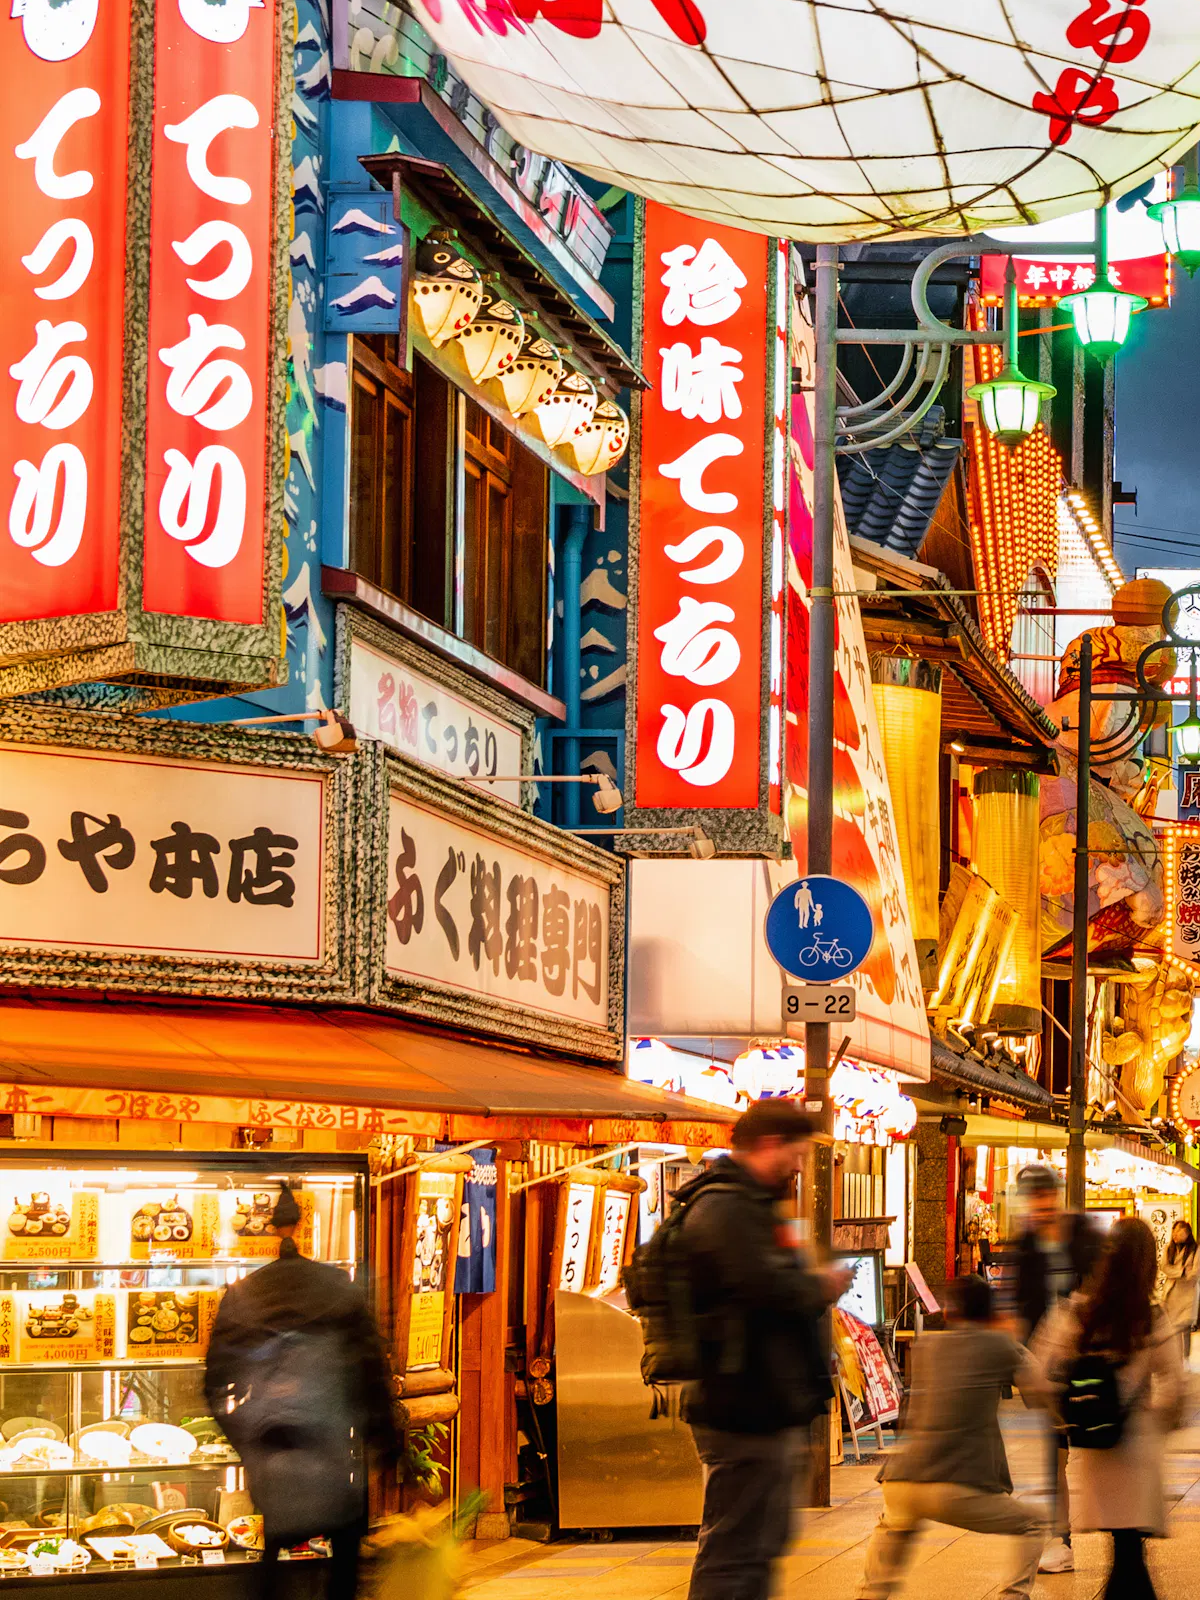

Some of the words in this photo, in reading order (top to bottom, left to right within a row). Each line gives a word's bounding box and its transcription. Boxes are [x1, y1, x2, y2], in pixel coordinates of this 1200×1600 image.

[9, 87, 101, 567] てっちり
[158, 94, 259, 568] てっちり
[653, 237, 748, 787] 珍味てっちり
[375, 671, 498, 784] 名物てっちり
[388, 827, 603, 1006] ふぐ料理専門
[105, 1092, 200, 1120] づぼらや
[251, 1102, 409, 1132] ふぐなら日本一
[28, 1247, 71, 1258] 2,500円
[0, 1299, 11, 1359] 焼ふぐ膳
[43, 1349, 88, 1360] 4,000円
[103, 1298, 114, 1357] ふぐ三味御膳
[146, 1348, 182, 1358] 5,400円
